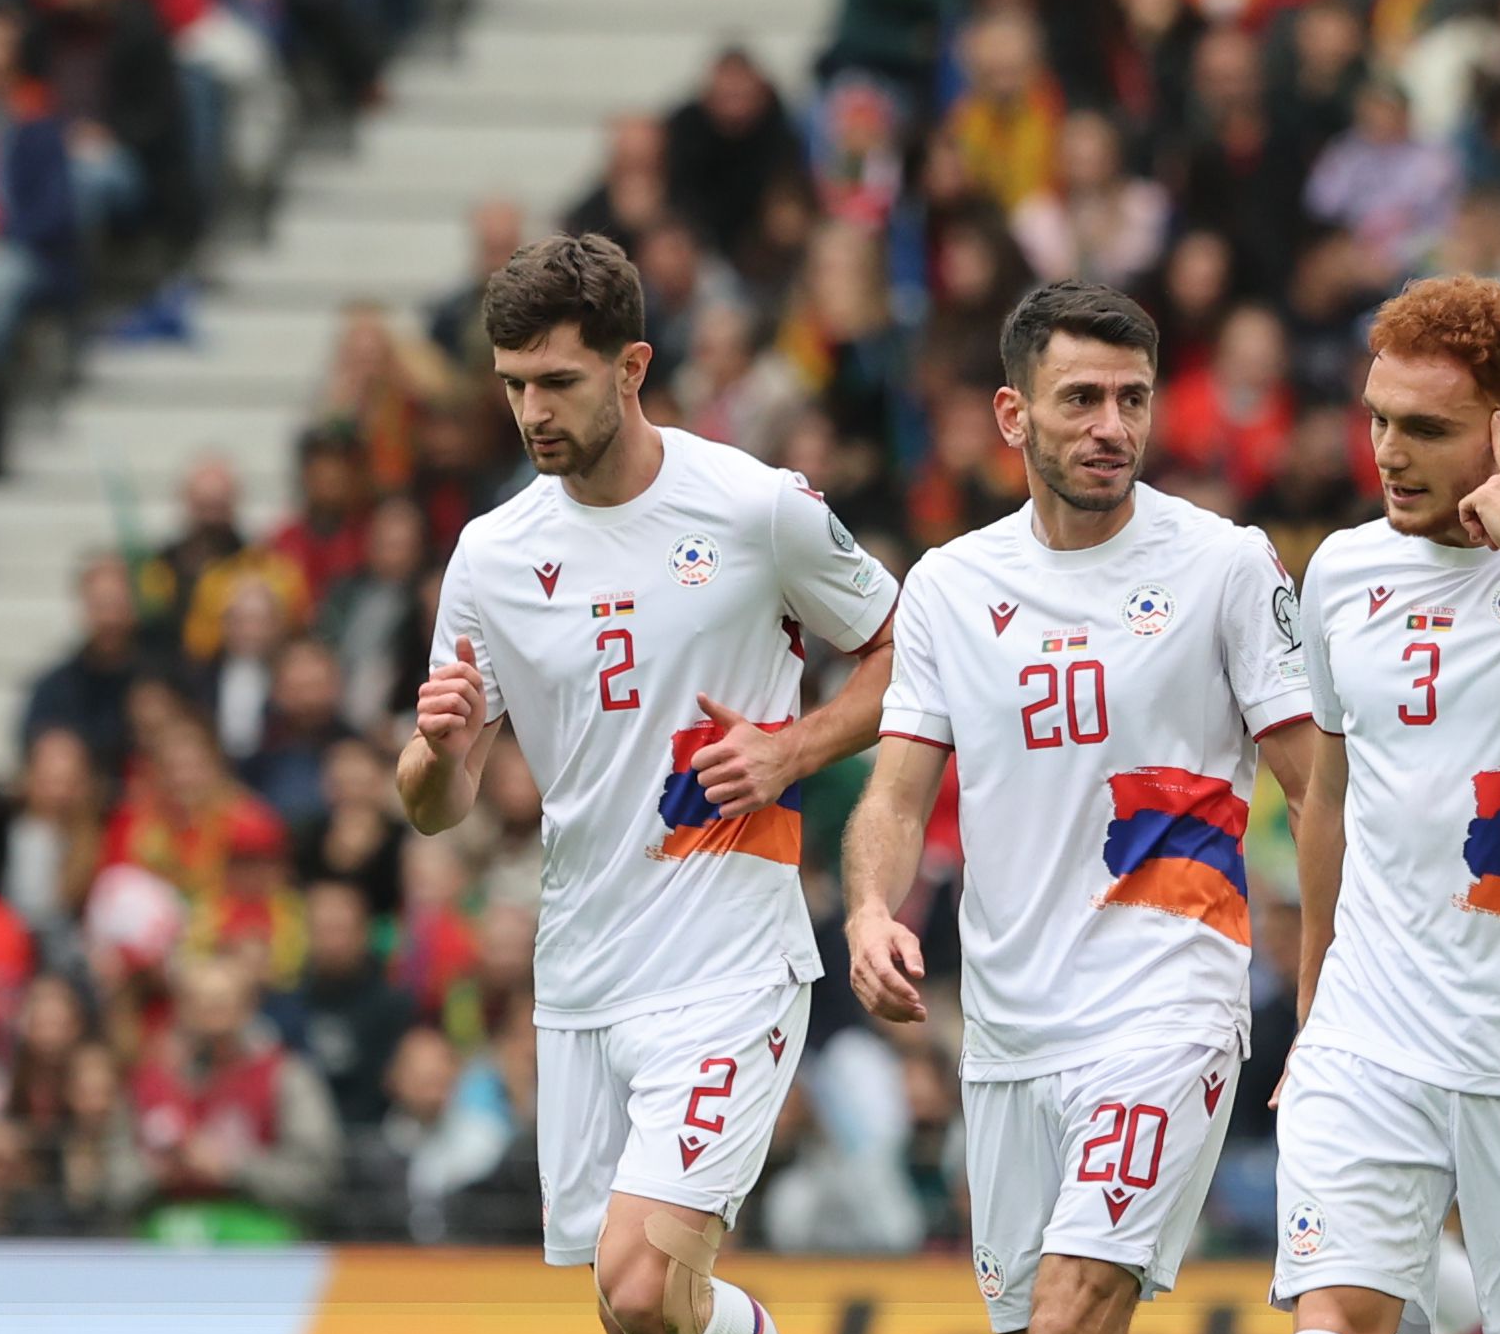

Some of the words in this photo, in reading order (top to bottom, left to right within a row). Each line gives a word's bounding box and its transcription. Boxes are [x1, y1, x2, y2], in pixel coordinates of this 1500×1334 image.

[596, 629, 640, 711] 2
[1019, 659, 1109, 749] 20
[1398, 642, 1441, 725] 3
[684, 1058, 737, 1134] 2
[1077, 1102, 1168, 1190] 20
